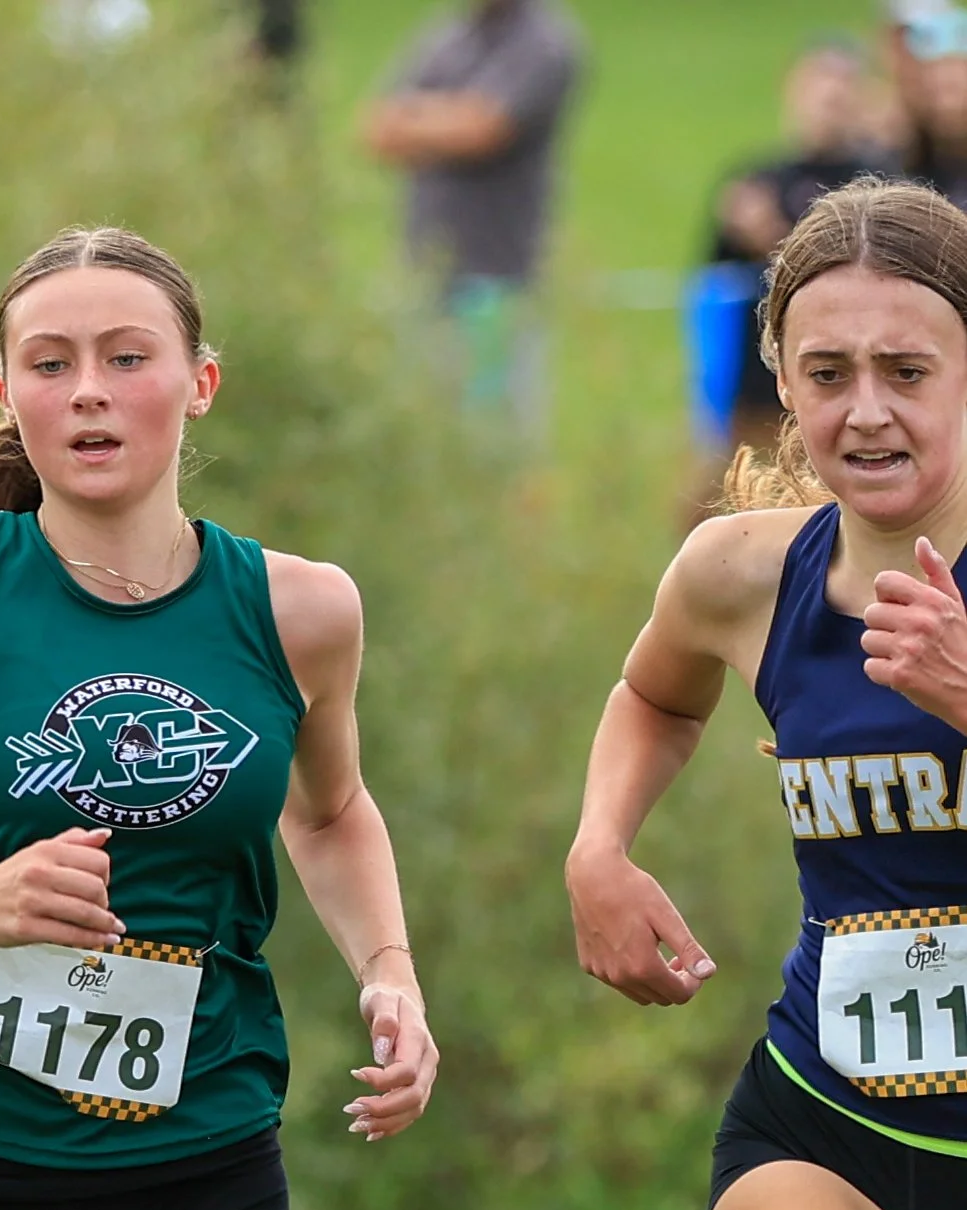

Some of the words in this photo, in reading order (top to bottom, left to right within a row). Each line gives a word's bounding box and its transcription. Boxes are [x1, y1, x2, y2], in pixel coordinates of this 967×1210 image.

[55, 677, 197, 718] WATERFORD
[66, 708, 203, 792] XC
[75, 771, 220, 824] KETTERING
[779, 752, 967, 839] ENTR
[67, 964, 114, 992] Ope!
[905, 941, 947, 972] Ope!
[843, 984, 967, 1065] 111
